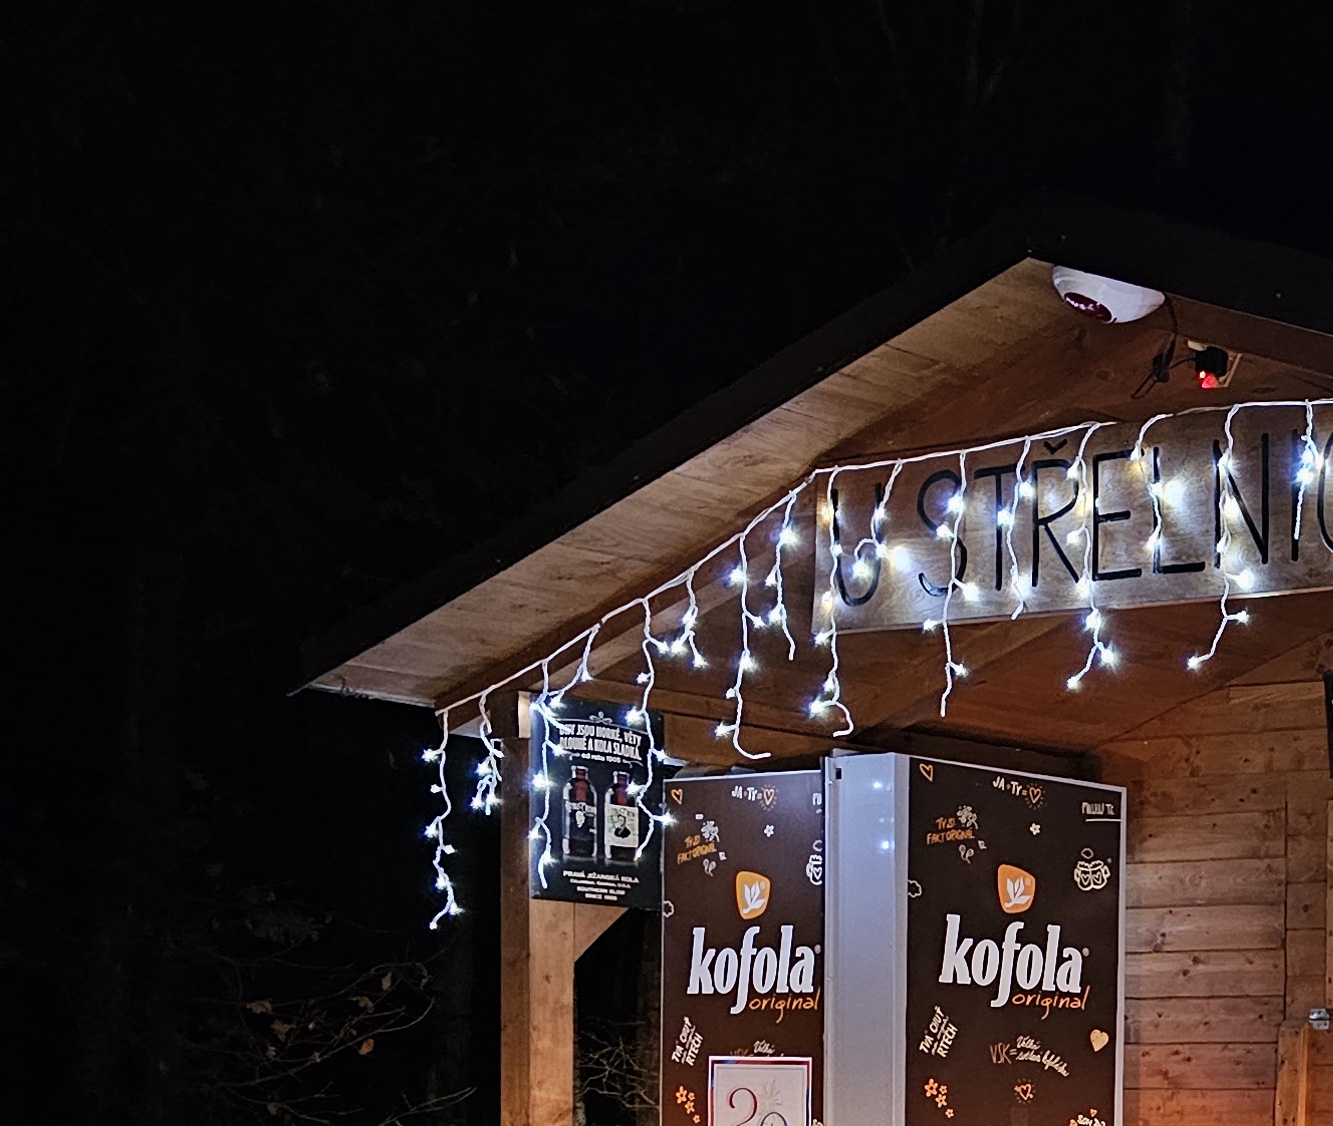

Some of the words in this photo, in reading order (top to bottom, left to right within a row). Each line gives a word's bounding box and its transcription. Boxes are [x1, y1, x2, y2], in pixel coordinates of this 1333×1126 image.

[831, 482, 882, 606] U
[687, 925, 815, 1014] kofola
[939, 913, 1082, 1007] kofola
[749, 987, 821, 1023] original
[1012, 986, 1090, 1020] original
[937, 1023, 958, 1057] RTECH
